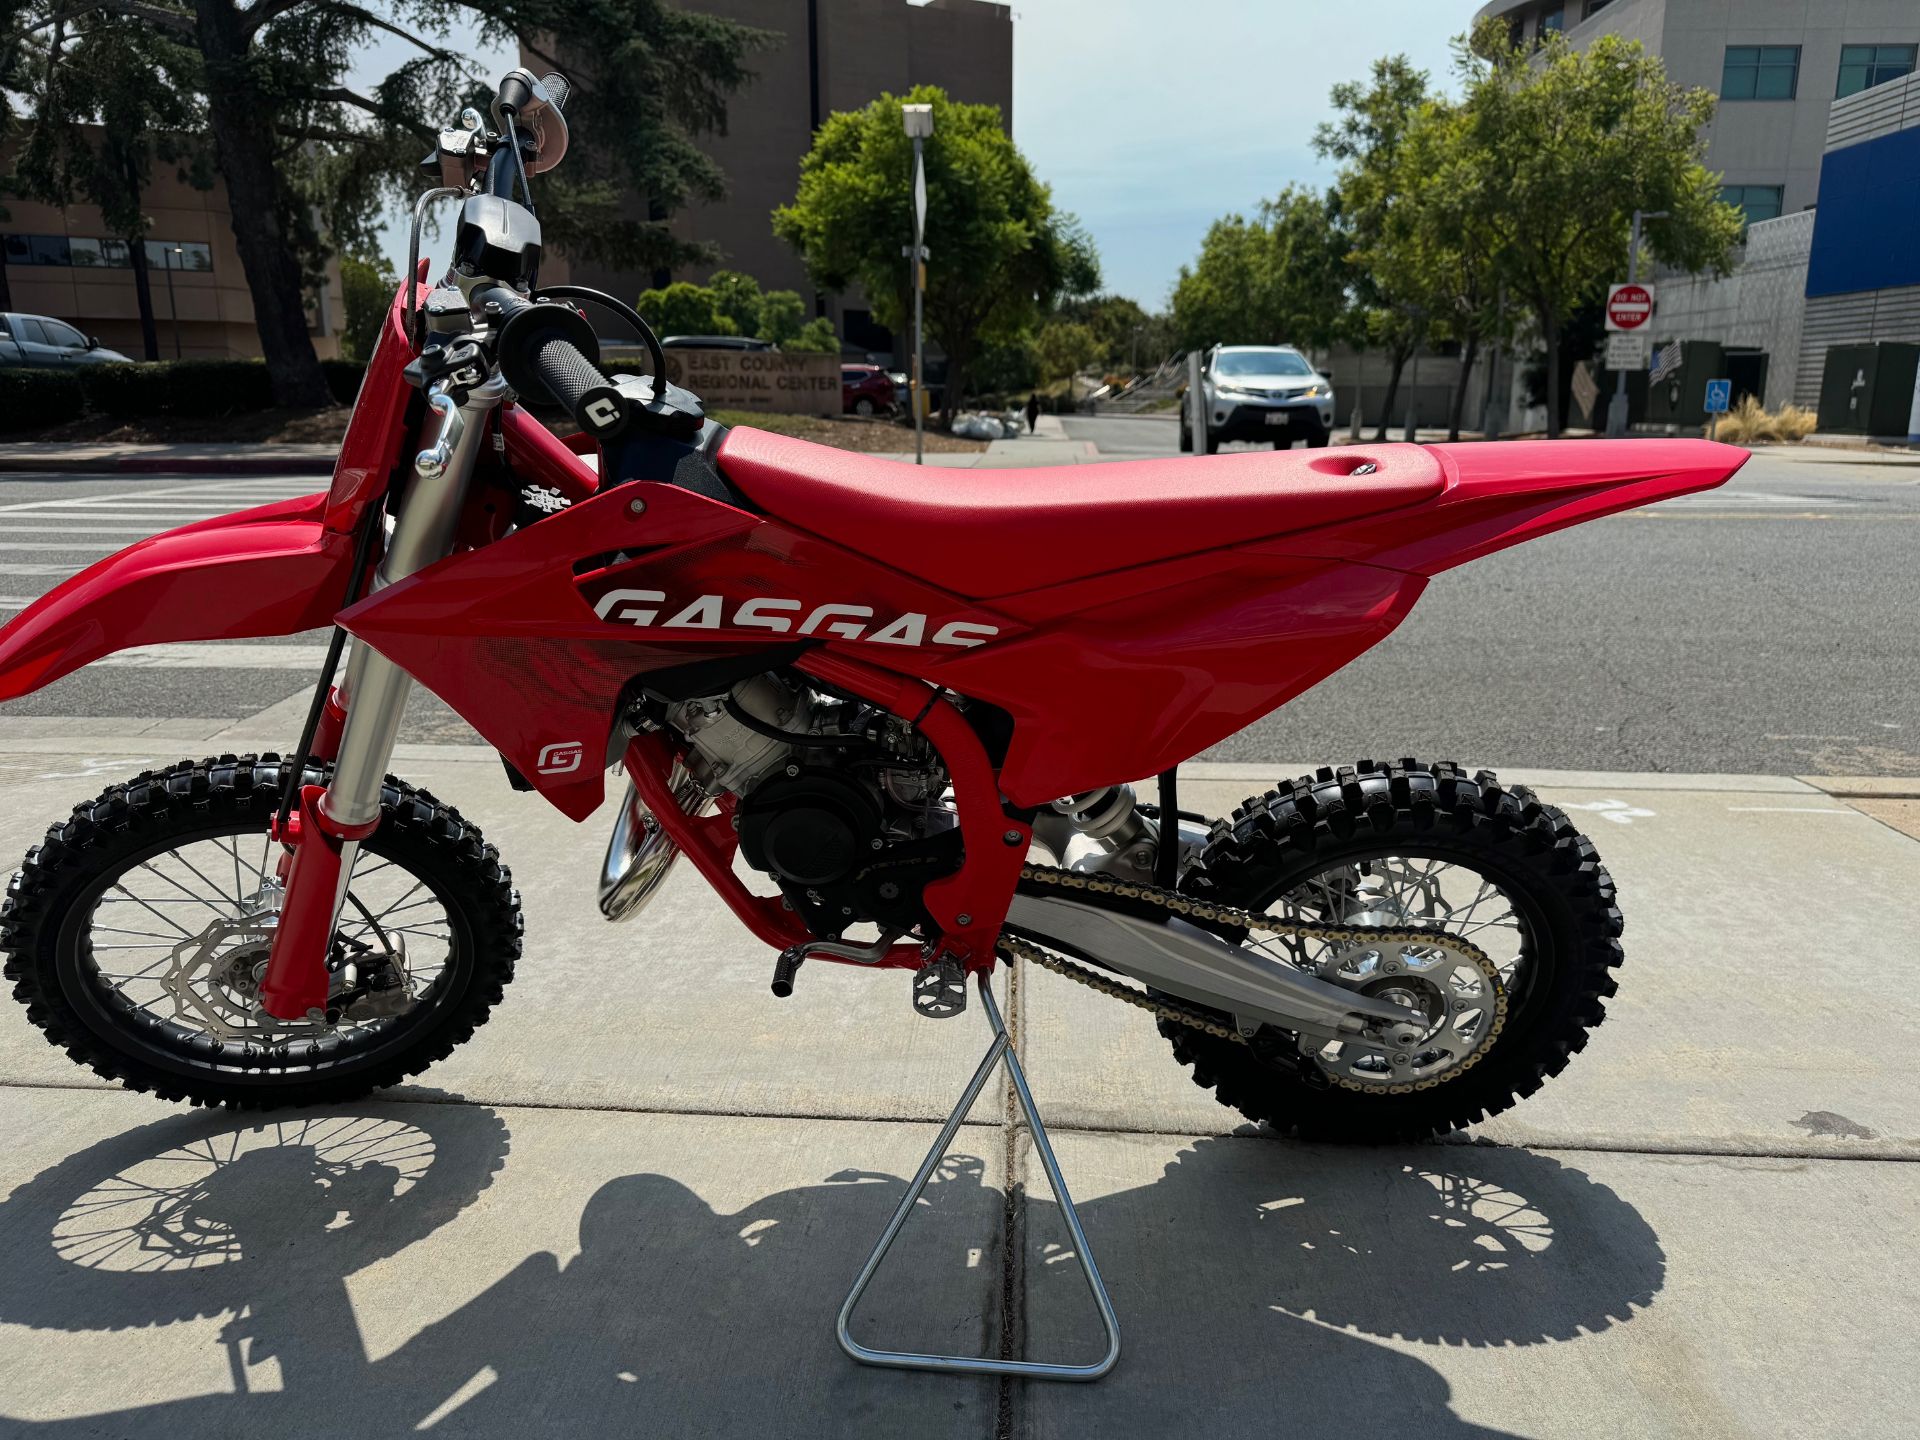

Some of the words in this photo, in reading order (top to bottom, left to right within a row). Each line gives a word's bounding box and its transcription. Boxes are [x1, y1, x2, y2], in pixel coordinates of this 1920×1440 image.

[1615, 293, 1628, 302] DO
[1630, 293, 1646, 302] NOT
[1615, 312, 1642, 322] ENTER
[688, 354, 730, 371] EAST
[740, 356, 806, 372] COUNTY
[688, 374, 771, 390] REGIONAL
[776, 375, 838, 391] CENTER
[593, 588, 999, 648] GASGAS
